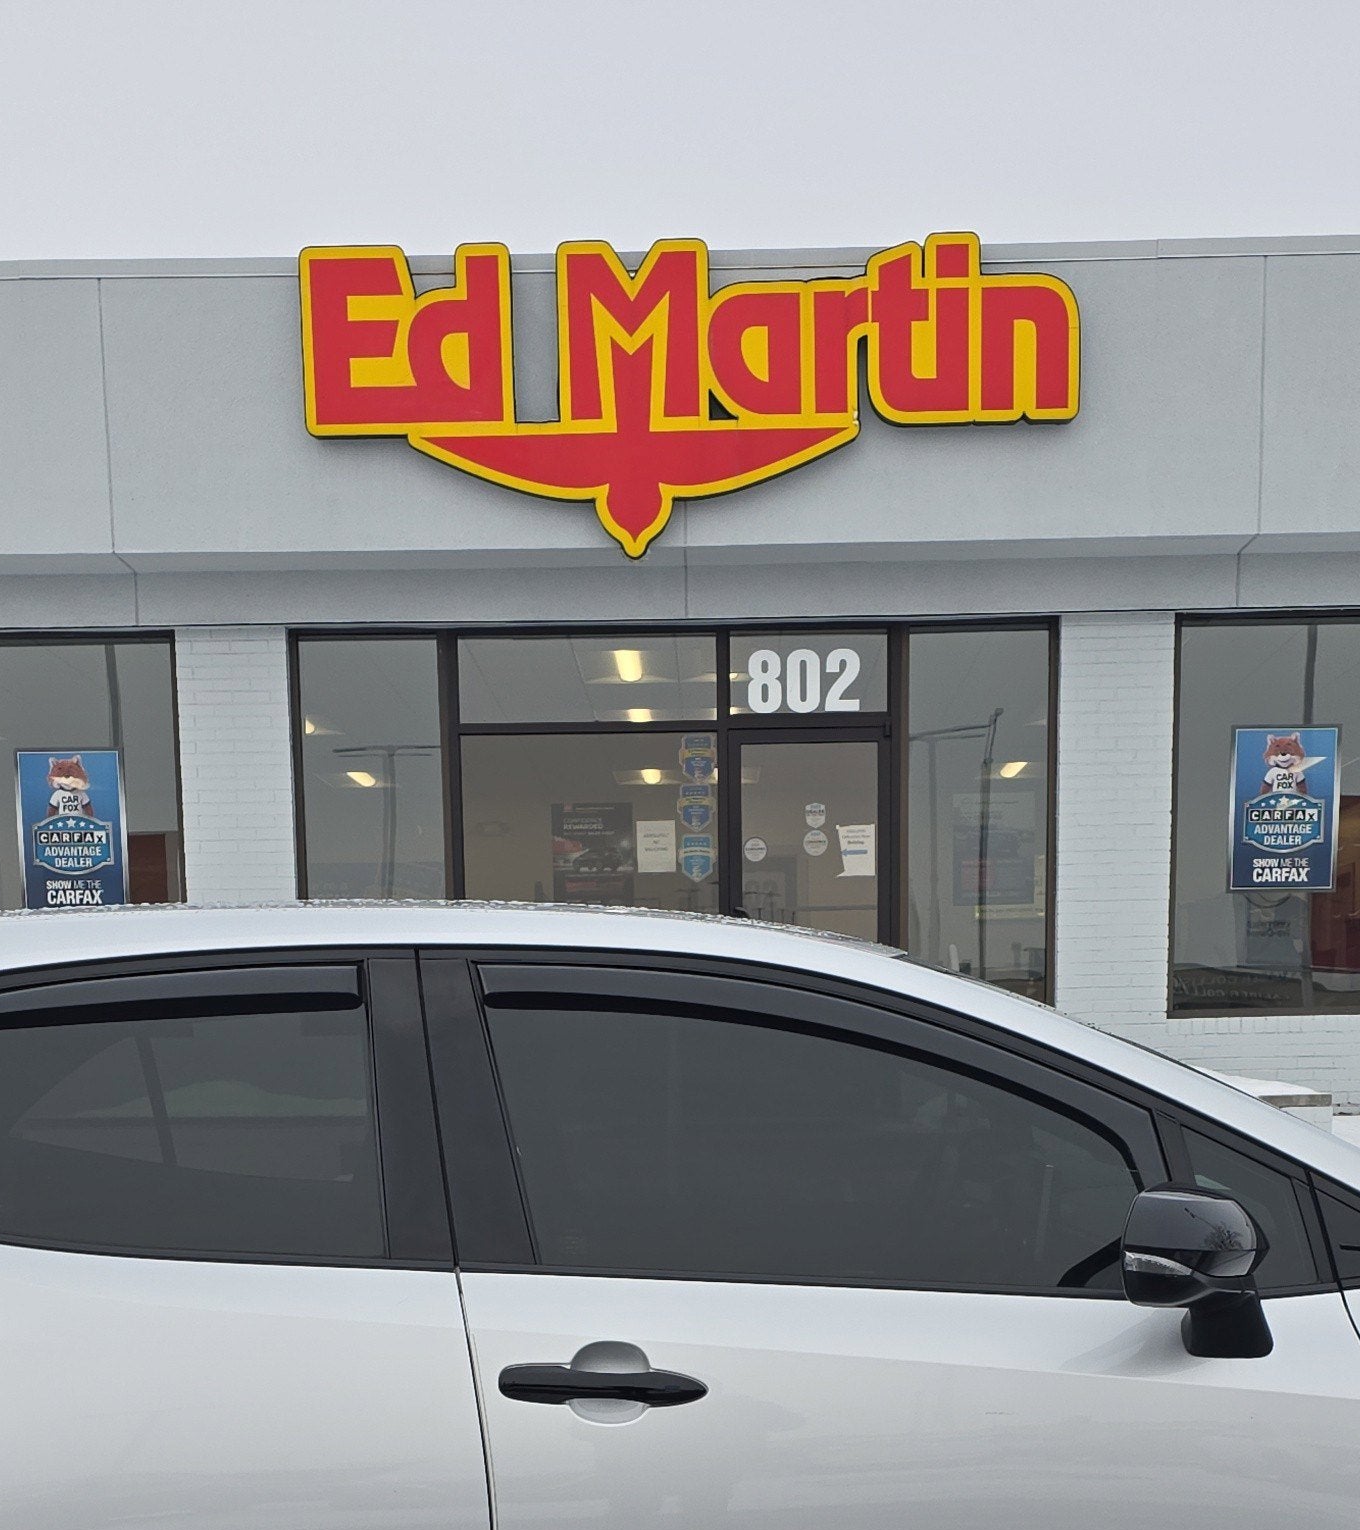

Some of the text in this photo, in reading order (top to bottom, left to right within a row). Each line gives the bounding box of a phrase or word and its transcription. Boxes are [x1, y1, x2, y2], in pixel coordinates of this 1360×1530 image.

[299, 232, 1081, 437] Ed Martin
[747, 648, 861, 714] 802
[1276, 773, 1294, 781] CAR
[1277, 781, 1294, 789] FOX
[61, 795, 79, 804] CAR
[63, 804, 79, 812] FOX
[1250, 809, 1317, 821] CARFAX
[1254, 824, 1312, 834] ADVANTAGE
[40, 832, 106, 844] CARFAX
[1264, 835, 1302, 846] DEALER
[44, 846, 102, 857] ADVANTAGE
[54, 857, 93, 868] DEALER
[1253, 858, 1279, 868] SHOW
[1294, 857, 1309, 867] THE
[1253, 867, 1309, 882] CARFAX
[46, 880, 72, 889] SHOW
[87, 880, 102, 889] THE
[47, 890, 104, 905] CARFAX
